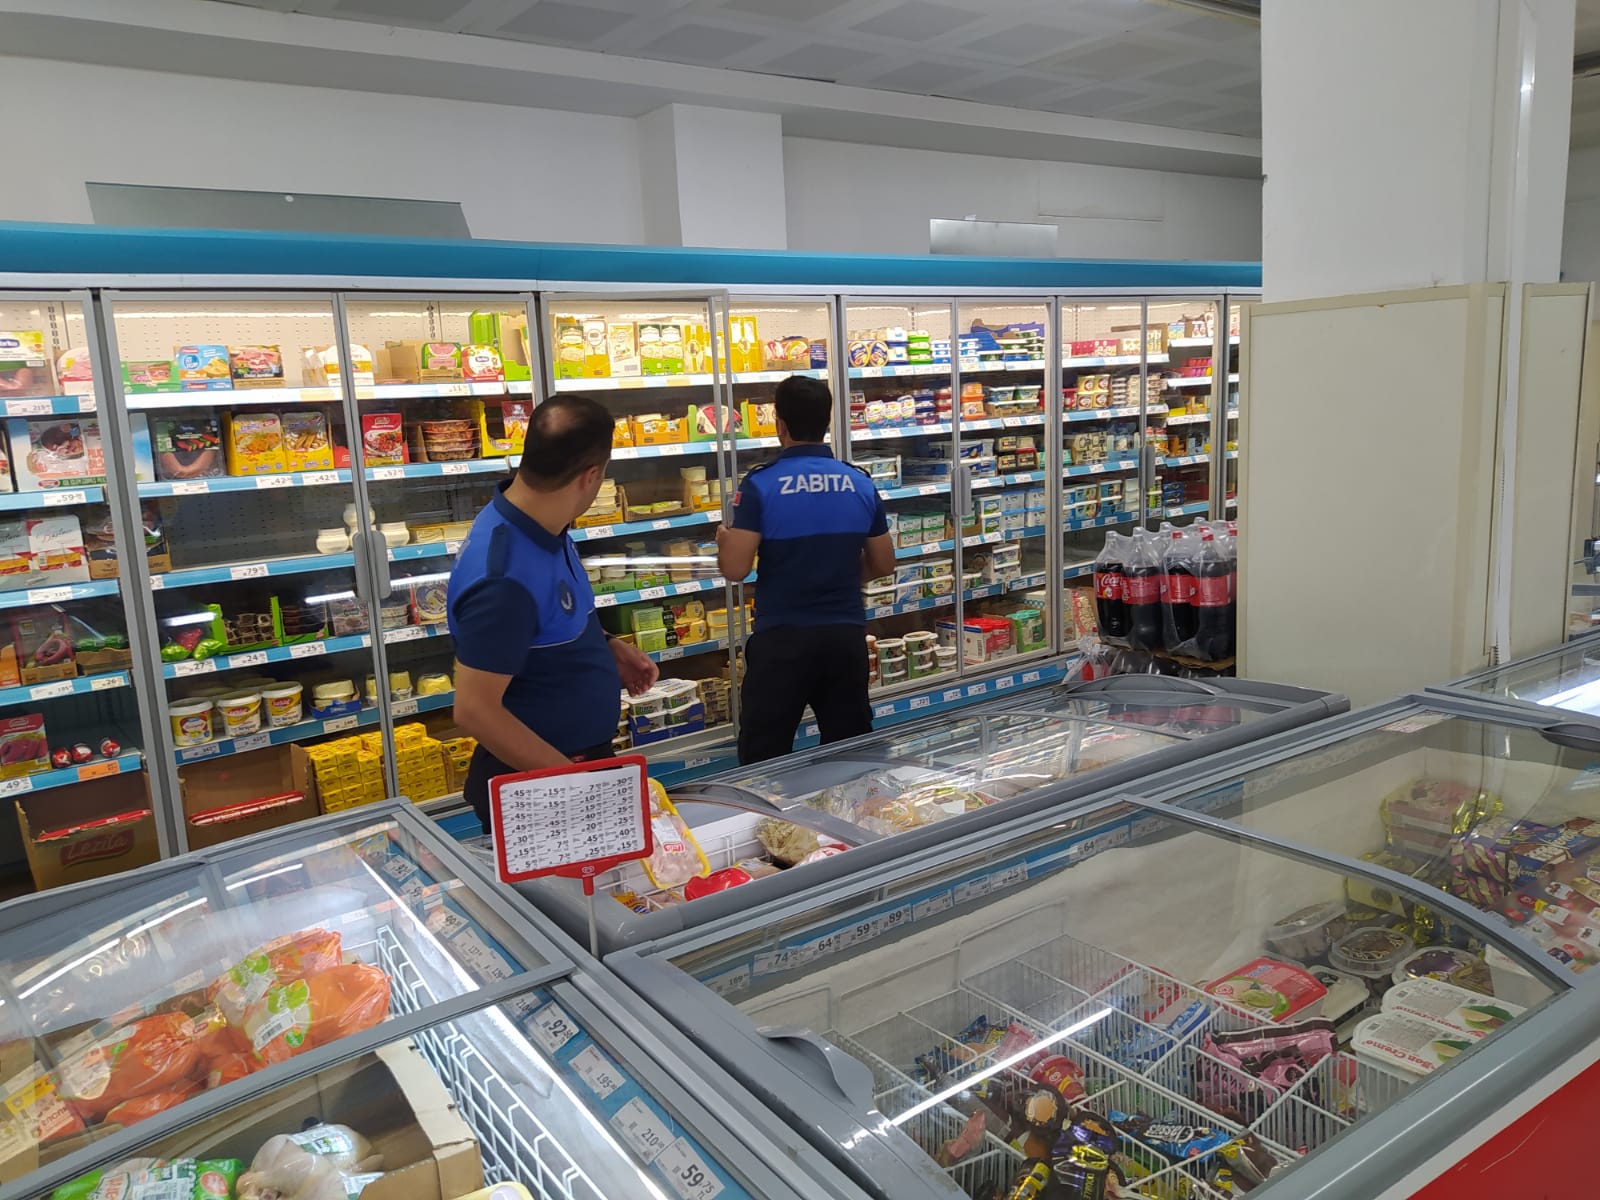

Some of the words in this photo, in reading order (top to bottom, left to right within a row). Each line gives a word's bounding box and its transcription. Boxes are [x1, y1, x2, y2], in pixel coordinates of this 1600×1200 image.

[778, 474, 856, 495] ZABITA
[6, 781, 20, 790] 49
[67, 835, 127, 860] Lezita
[1008, 870, 1018, 880] 25
[888, 910, 902, 923] 89
[856, 923, 870, 937] 59
[818, 938, 832, 952] 64
[774, 952, 788, 965] 74
[548, 1019, 568, 1038] 92
[1366, 1039, 1406, 1060] Cremo
[1408, 1055, 1433, 1070] Bon
[596, 1072, 613, 1088] 195
[641, 1128, 658, 1146] 210
